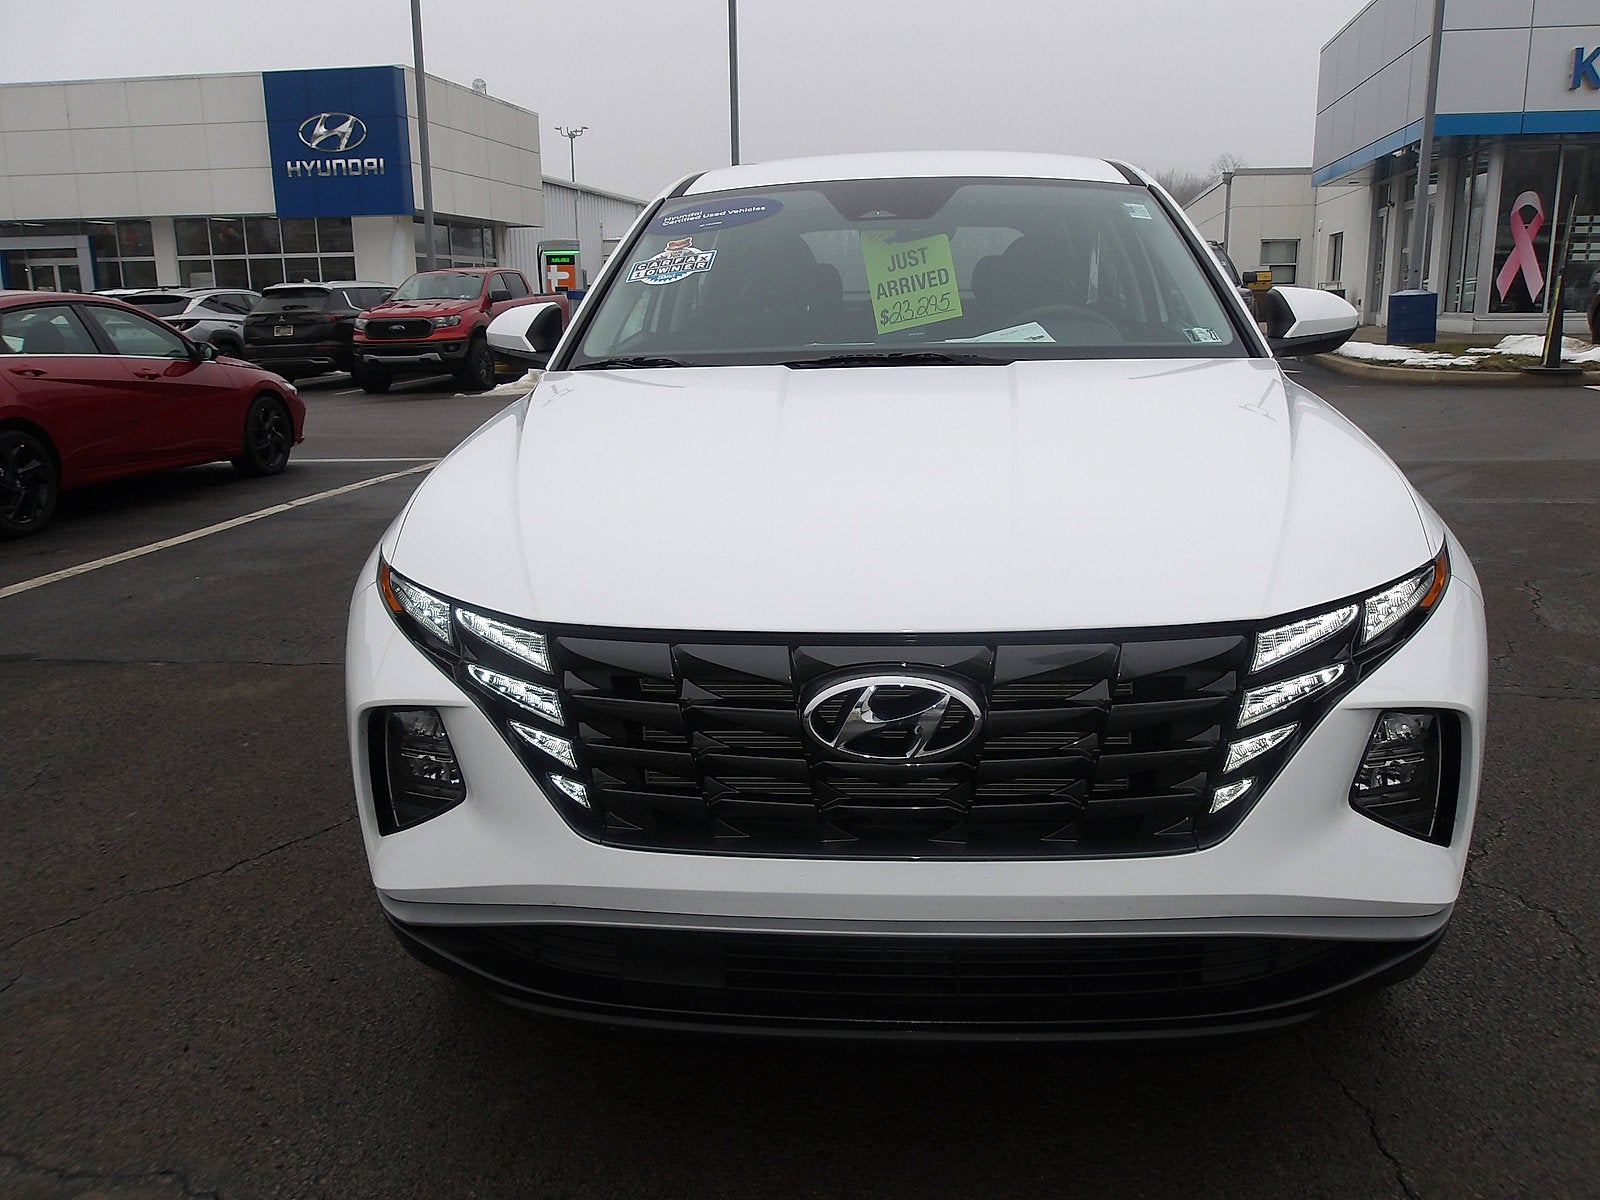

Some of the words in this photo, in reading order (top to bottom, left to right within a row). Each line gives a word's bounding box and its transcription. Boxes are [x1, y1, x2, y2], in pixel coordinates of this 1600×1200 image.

[286, 157, 385, 178] HYUNDAI
[662, 215, 702, 226] Certified
[702, 210, 727, 219] Used
[727, 205, 766, 216] Vehicles
[663, 210, 703, 222] Hyundai
[636, 255, 711, 271] CARFAX
[645, 262, 707, 277] OWNER
[887, 247, 928, 272] JUST
[876, 267, 950, 300] ARRIVED
